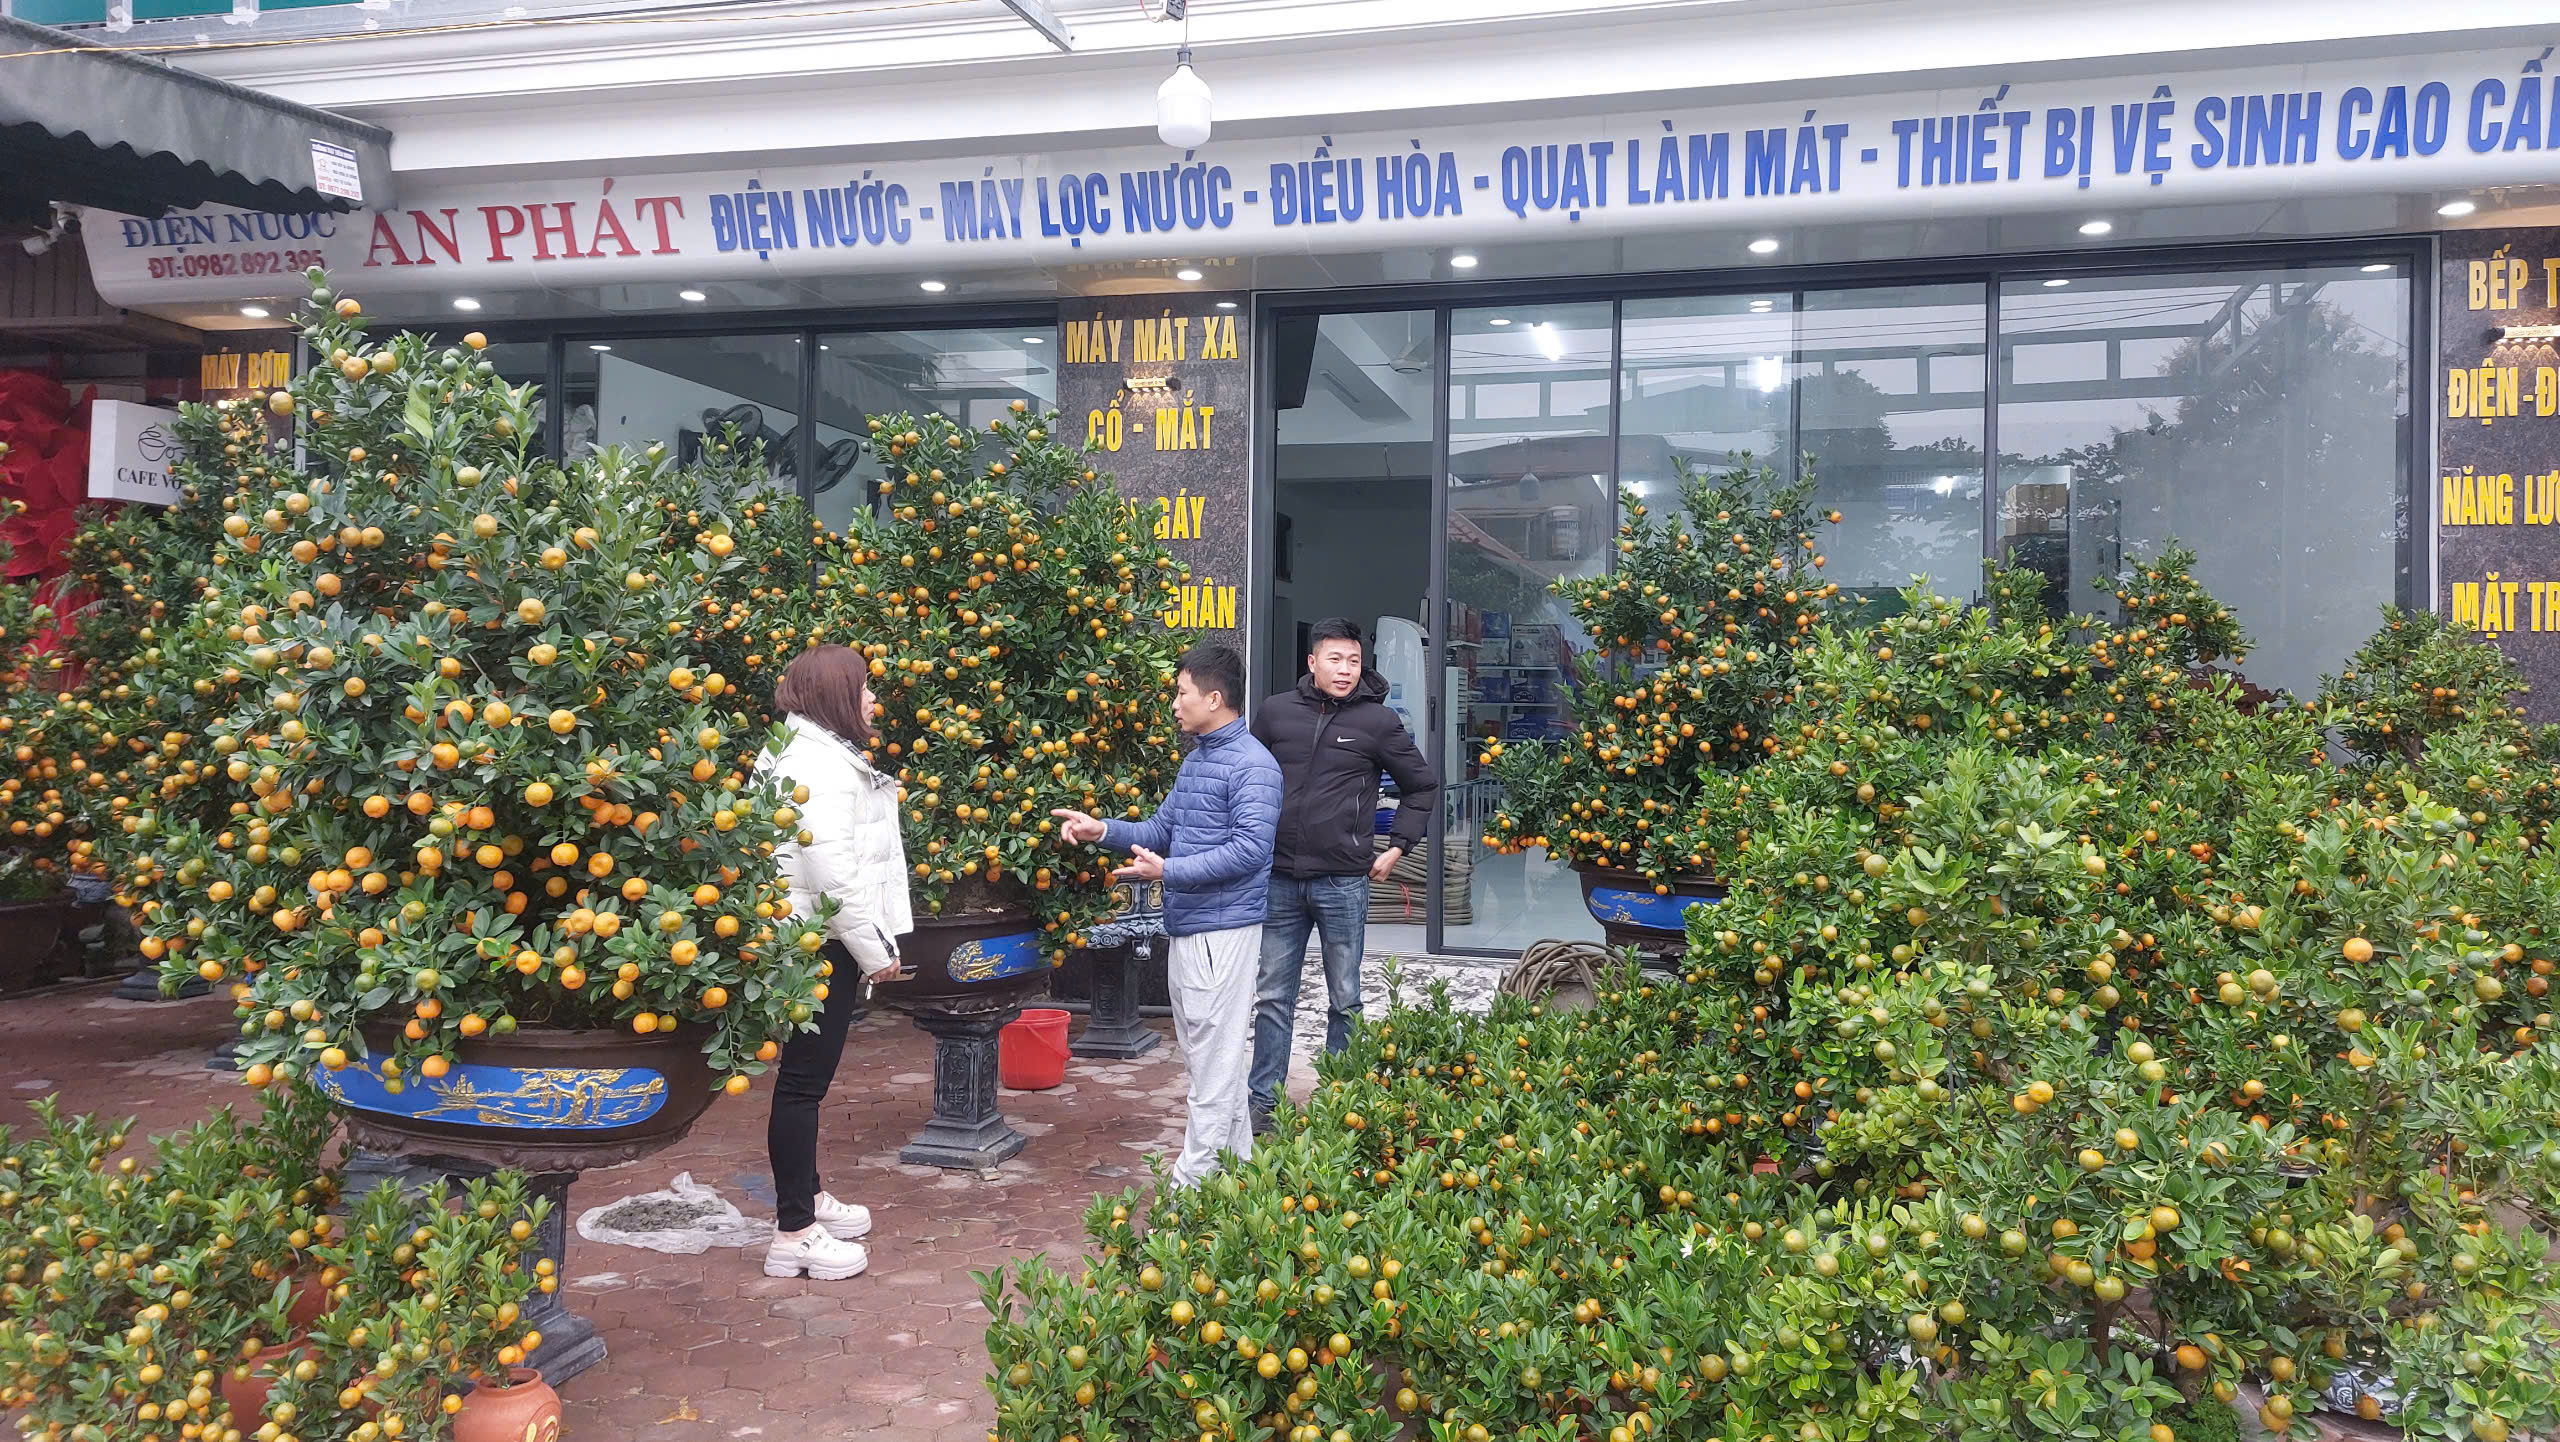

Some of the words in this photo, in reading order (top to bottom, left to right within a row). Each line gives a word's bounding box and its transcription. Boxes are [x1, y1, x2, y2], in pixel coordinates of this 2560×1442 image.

[711, 179, 798, 260] ĐIỆN
[804, 170, 910, 248] NƯỚC
[940, 167, 1024, 241] MÁY
[1037, 173, 1110, 248] LỌC
[1121, 150, 1233, 233] NƯỚC
[1270, 136, 1364, 225] ĐIỀU
[1377, 139, 1462, 219] HÒA
[1502, 141, 1613, 221] QUẠT
[1628, 120, 1730, 205] LÀM
[1744, 110, 1848, 197] MÁT
[1892, 85, 2031, 188] THIẾT
[2044, 106, 2095, 189] BỊ
[2111, 85, 2175, 185] VỆ
[2191, 92, 2322, 168] SINH
[2336, 82, 2450, 160] CAO
[364, 211, 462, 266] AN
[478, 177, 684, 262] PHÁT
[240, 250, 282, 274] 892
[2469, 244, 2529, 310] BẾP
[1066, 312, 1123, 363] MÁY
[1133, 309, 1189, 363] MÁT
[1201, 315, 1238, 360] XA
[202, 347, 240, 389] MÁY
[248, 349, 290, 388] BƠM
[1088, 389, 1123, 452] CỔ
[1155, 390, 1214, 450] MẮT
[118, 467, 157, 486] CAFE
[2442, 465, 2513, 525] NĂNG
[2524, 470, 2560, 525] LƯ
[1154, 488, 1205, 539] GÁY
[1164, 577, 1236, 629] CHÂN
[2452, 572, 2519, 639] MẶT
